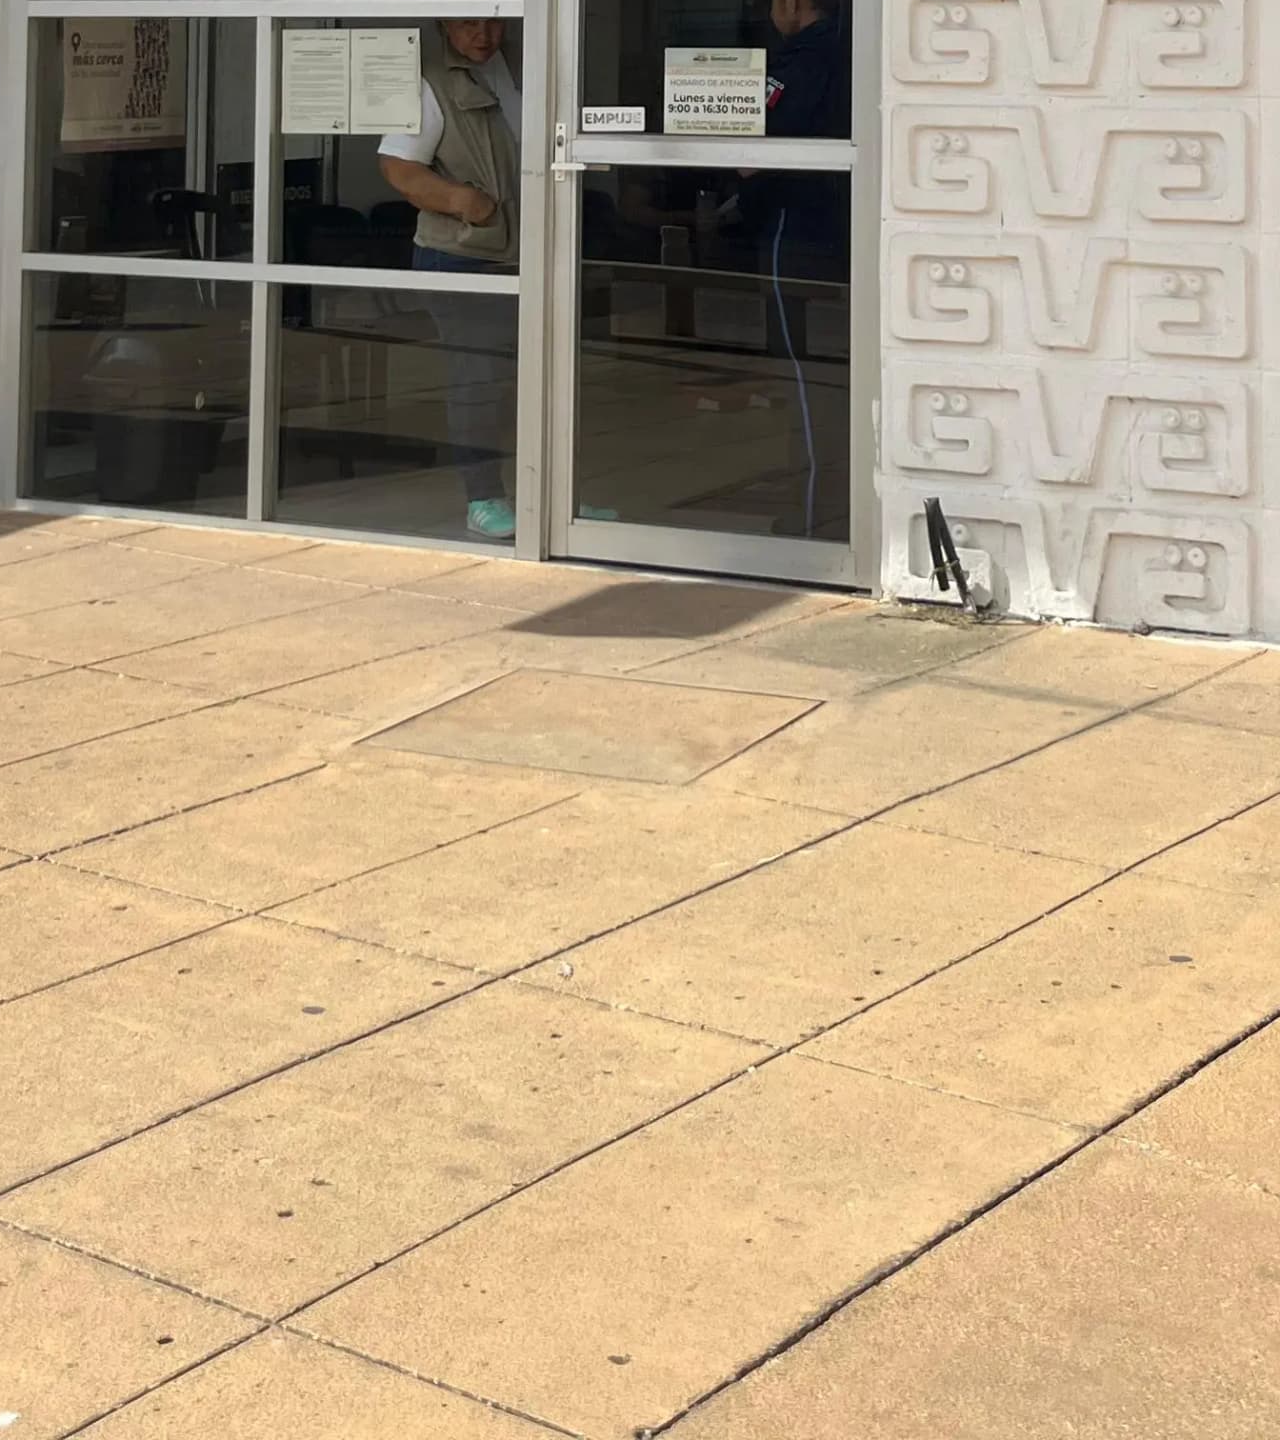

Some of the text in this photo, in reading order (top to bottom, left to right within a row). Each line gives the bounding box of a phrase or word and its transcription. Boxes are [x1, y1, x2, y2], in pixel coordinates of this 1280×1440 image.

[671, 79, 706, 87] HORARIO
[707, 79, 718, 87] DE
[673, 93, 705, 103] Lunes
[717, 93, 756, 103] viernes
[668, 104, 691, 113] 9:00
[703, 104, 728, 114] 16:30
[731, 105, 761, 114] horas
[584, 112, 643, 124] EMPUJE
